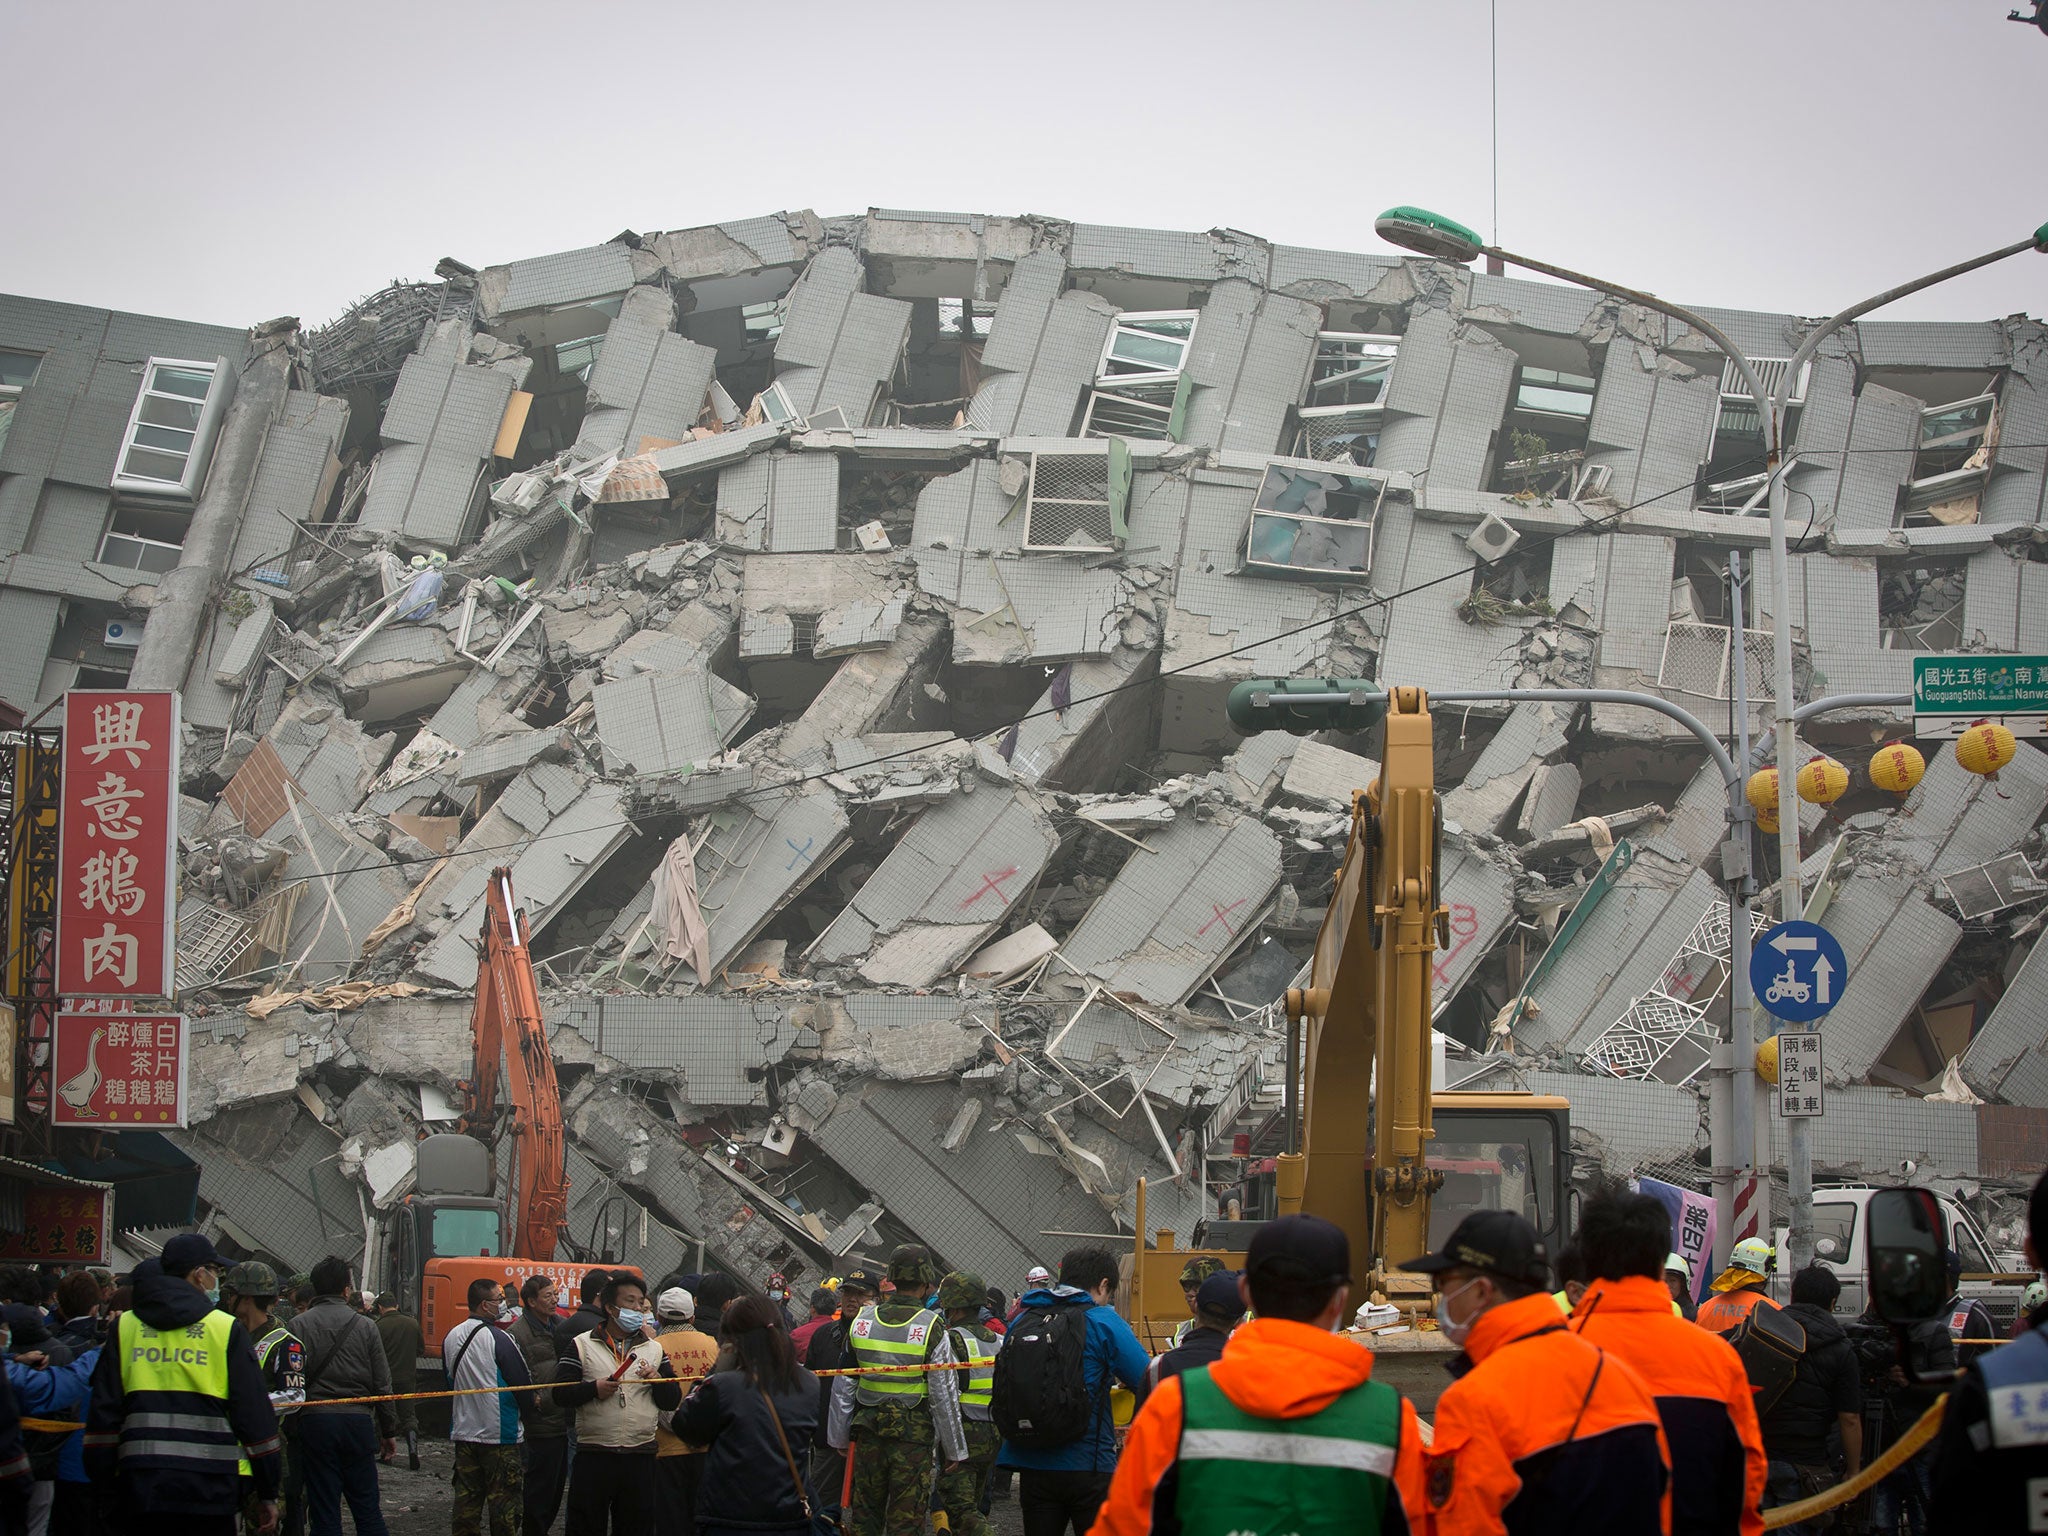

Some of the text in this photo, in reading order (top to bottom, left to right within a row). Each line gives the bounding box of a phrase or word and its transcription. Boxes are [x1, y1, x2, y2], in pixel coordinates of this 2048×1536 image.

[1925, 667, 1986, 687] 國光五街
[1925, 689, 1962, 704] Guoguang
[1962, 688, 1977, 701] 5th
[1977, 688, 1988, 701] St.
[79, 700, 152, 988] 興意鵝肉
[105, 1021, 129, 1105] 醉鵝
[153, 1023, 177, 1105] 白片鵝
[1783, 1037, 1801, 1113] 兩段左轉
[1802, 1037, 1819, 1112] 機慢車
[505, 1266, 590, 1278] 09138062
[1713, 1303, 1747, 1318] FIRE
[853, 1320, 924, 1342] 憲 兵
[132, 1347, 208, 1366] POLICE
[285, 1374, 306, 1388] MP
